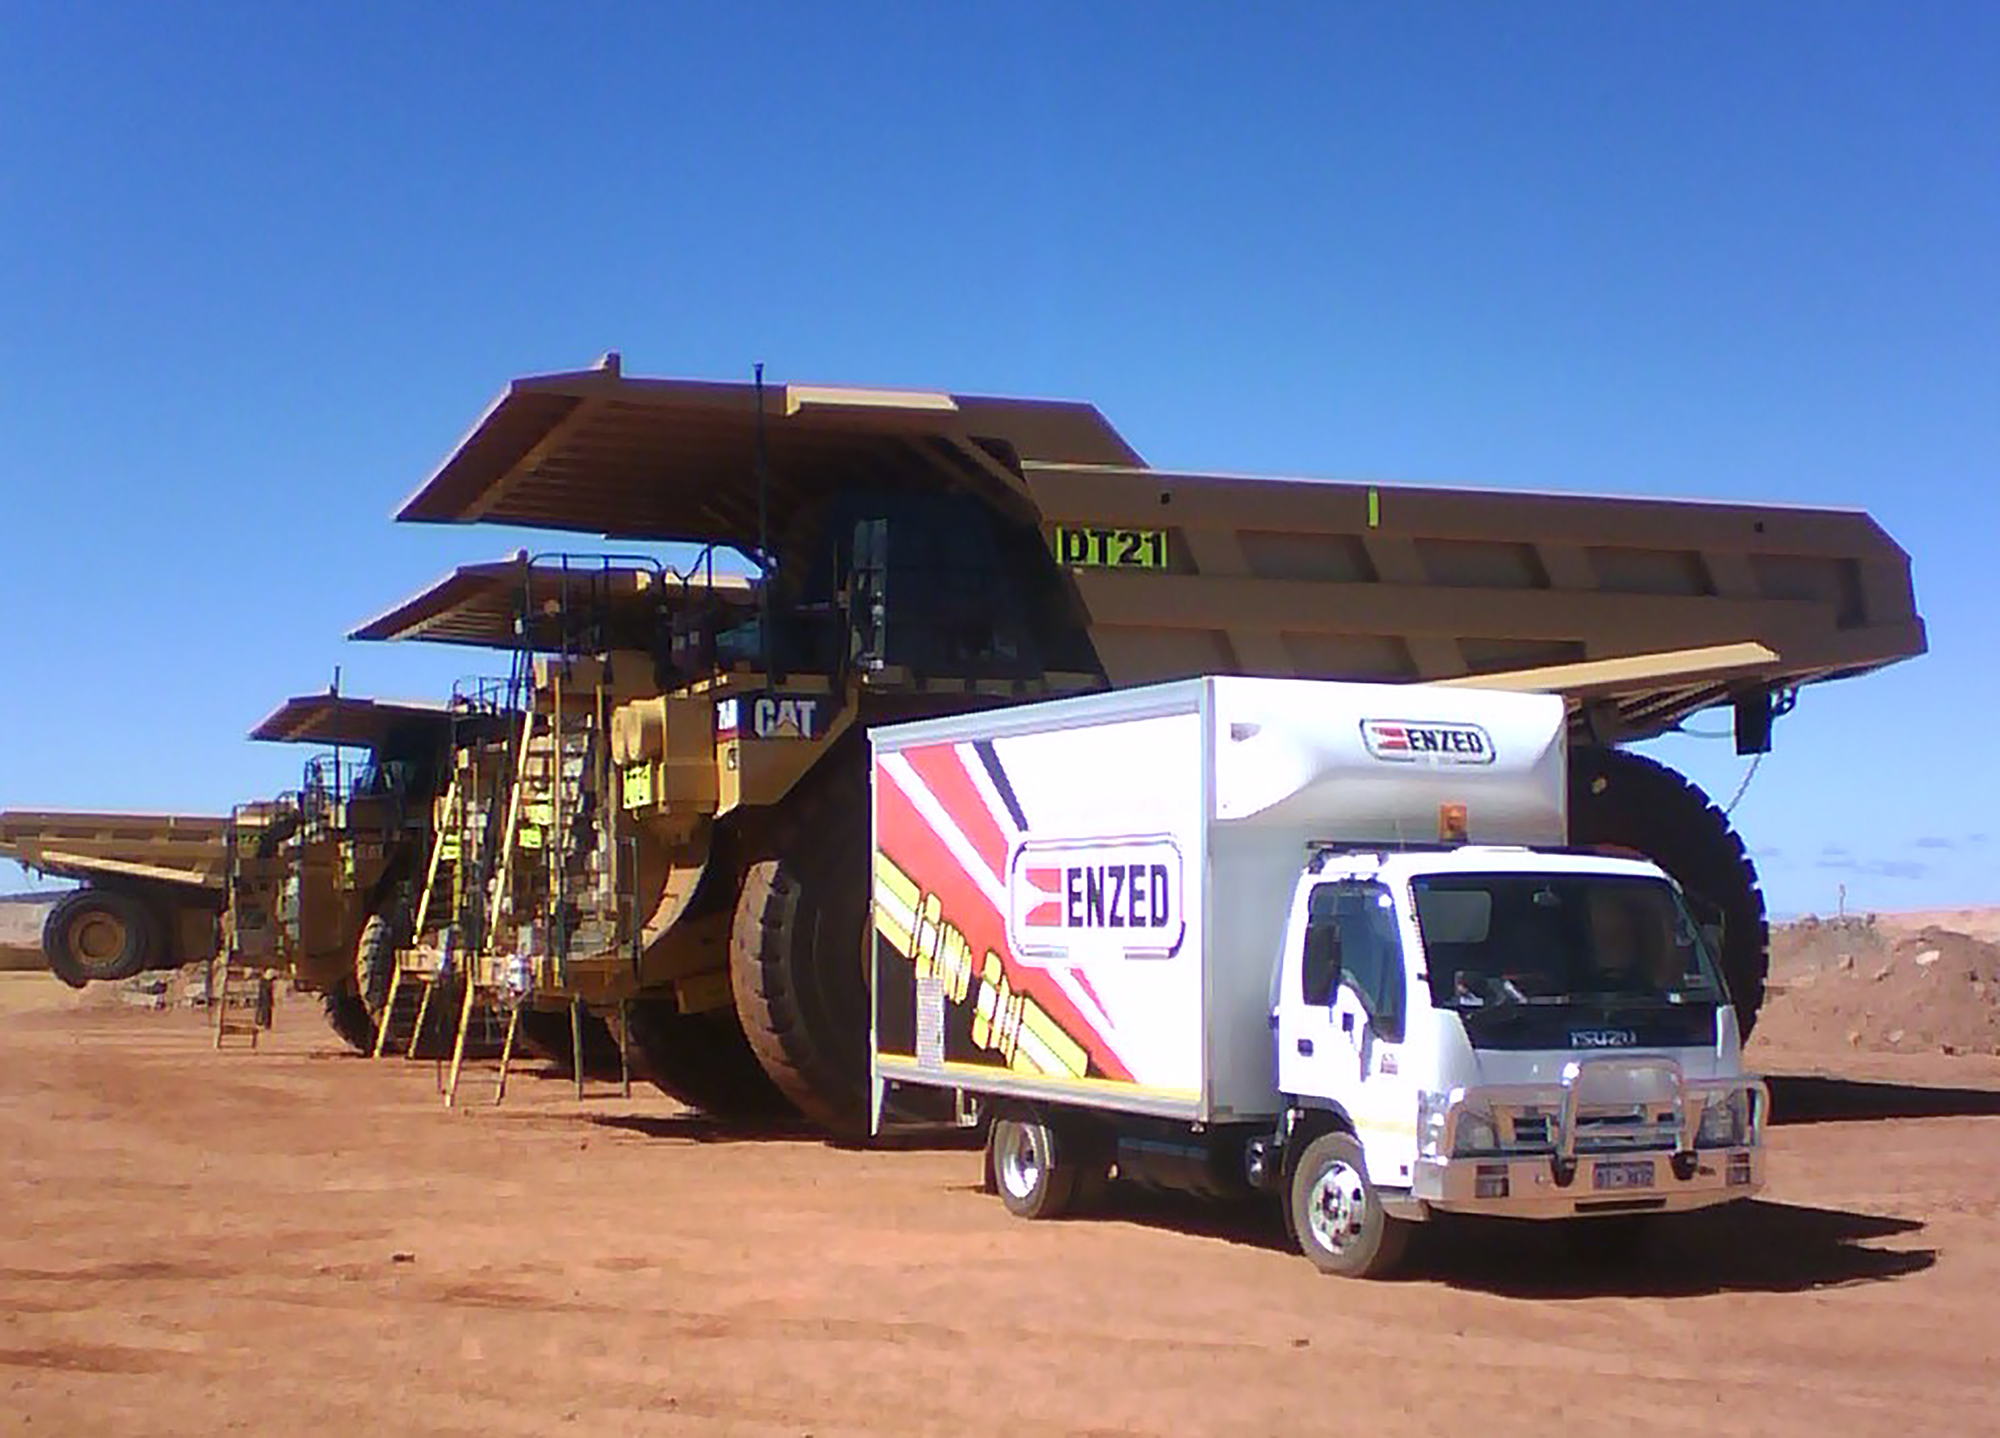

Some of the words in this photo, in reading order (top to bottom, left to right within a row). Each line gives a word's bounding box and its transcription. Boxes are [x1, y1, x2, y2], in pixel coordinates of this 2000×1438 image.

[1061, 528, 1162, 565] DT21
[755, 698, 817, 738] CAT
[1404, 727, 1483, 753] ENZED
[1067, 864, 1169, 928] ENZED
